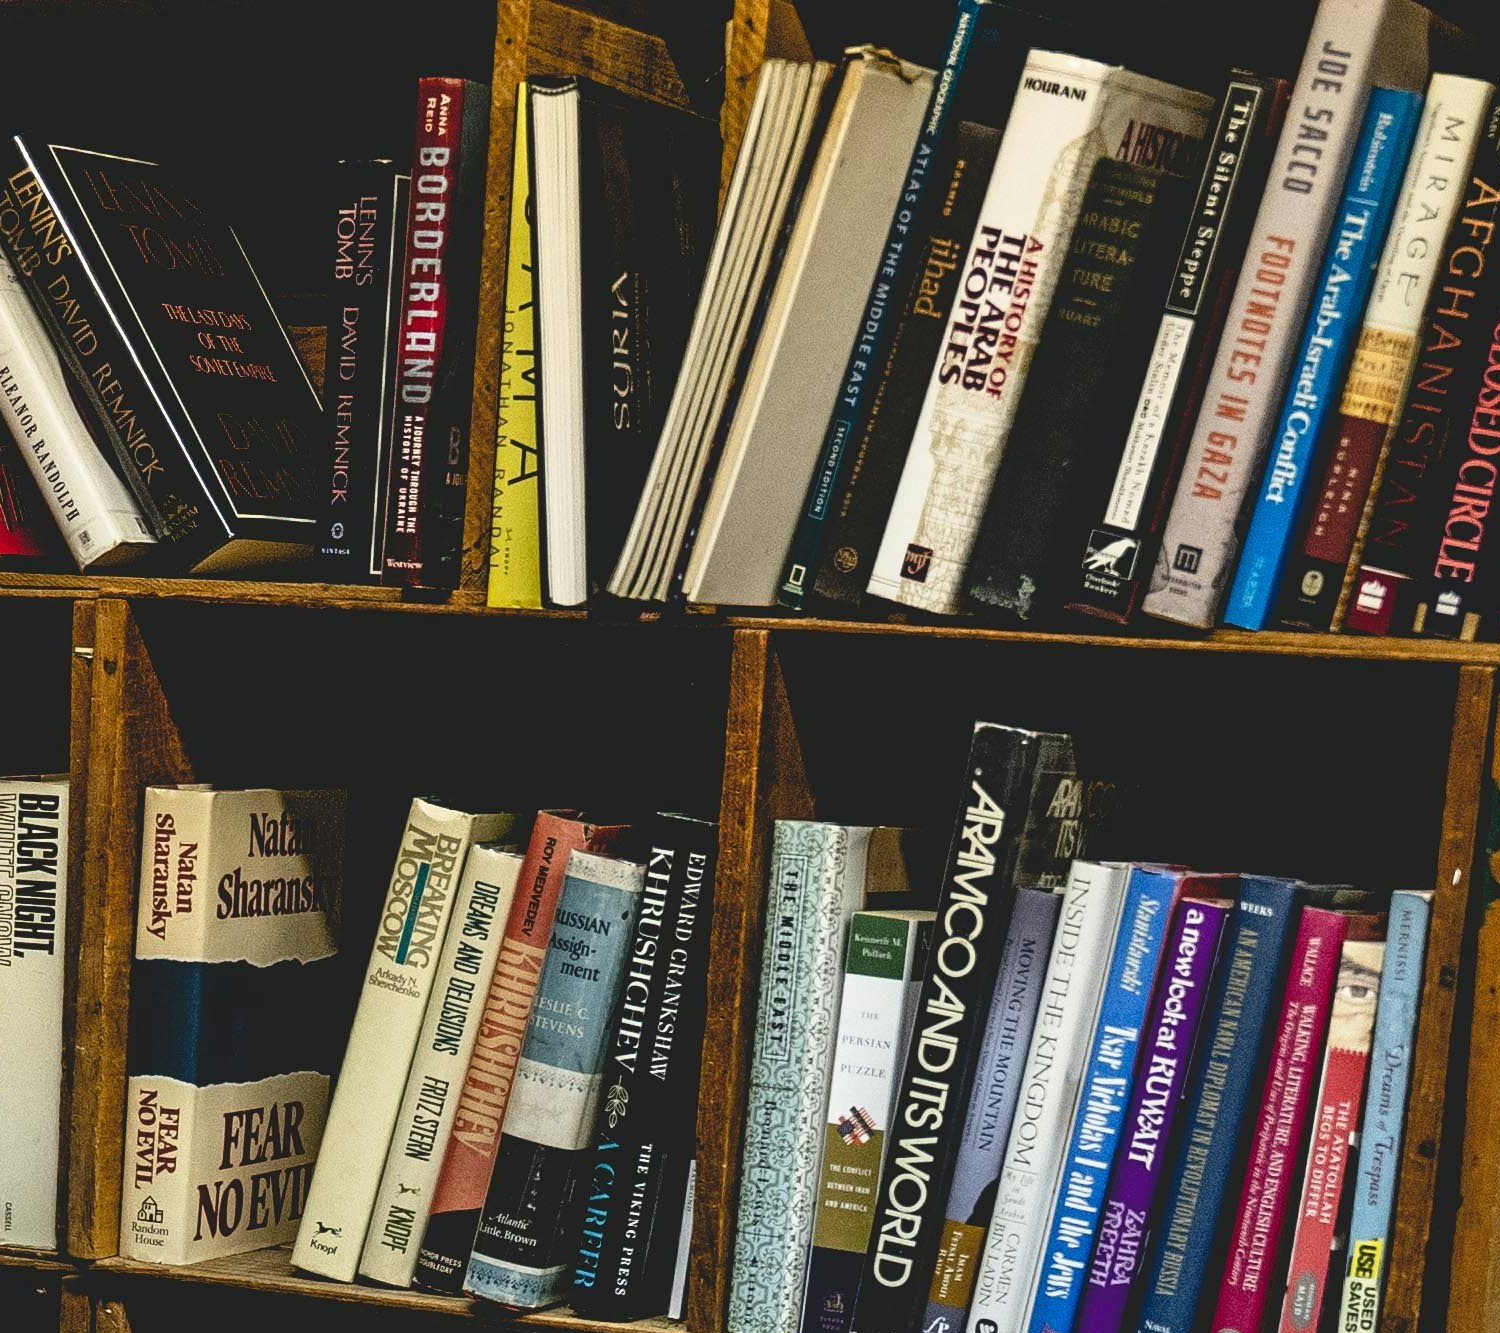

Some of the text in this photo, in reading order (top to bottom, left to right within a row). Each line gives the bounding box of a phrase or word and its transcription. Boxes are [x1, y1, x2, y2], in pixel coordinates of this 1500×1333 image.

[1024, 78, 1086, 102] HOURANI
[9, 168, 72, 268] LENIN'S
[402, 147, 450, 404] BORDERLAND
[1180, 101, 1251, 299] The Silent Steppe
[1192, 41, 1352, 500] JOE SACCO FOOTNOTES IN GAZA
[47, 274, 165, 486] DAVID REMNICK
[32, 439, 79, 523] RANDOLPH
[14, 794, 59, 958] BLACK NIGHT,
[148, 814, 175, 936] Sharansky
[176, 843, 198, 914] Natan
[377, 825, 434, 964] MOSCOW
[405, 835, 462, 969] BREAKING
[432, 881, 500, 1057] DREAMS AND DELUSIONS
[617, 847, 676, 1074] KHRUSHCHEV
[652, 852, 707, 1081] EDWARD CRANKSHAW
[875, 781, 1005, 1288] ARAMCO AND ITS WORLD
[134, 1091, 158, 1190] NO EVIL
[157, 1108, 181, 1175] FEAR
